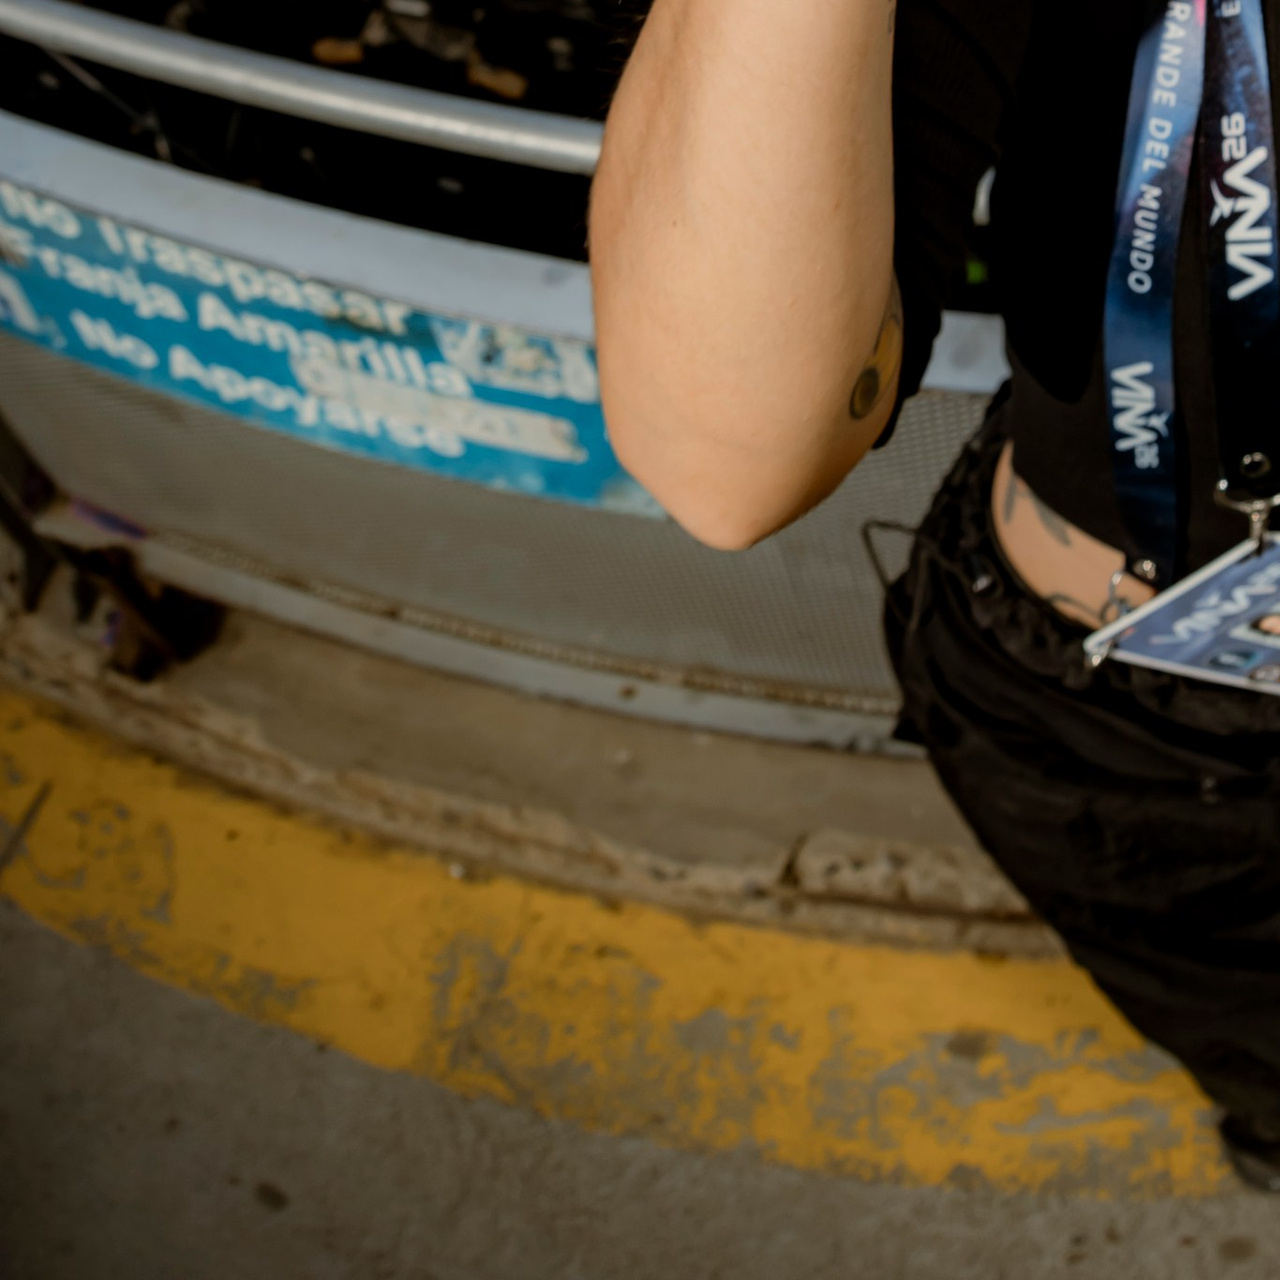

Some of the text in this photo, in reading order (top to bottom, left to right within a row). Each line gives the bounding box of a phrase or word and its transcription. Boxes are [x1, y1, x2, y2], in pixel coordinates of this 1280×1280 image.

[1142, 116, 1174, 173] DEL
[1, 182, 82, 239] No
[1126, 182, 1163, 295] MUNDO
[69, 308, 160, 370] No
